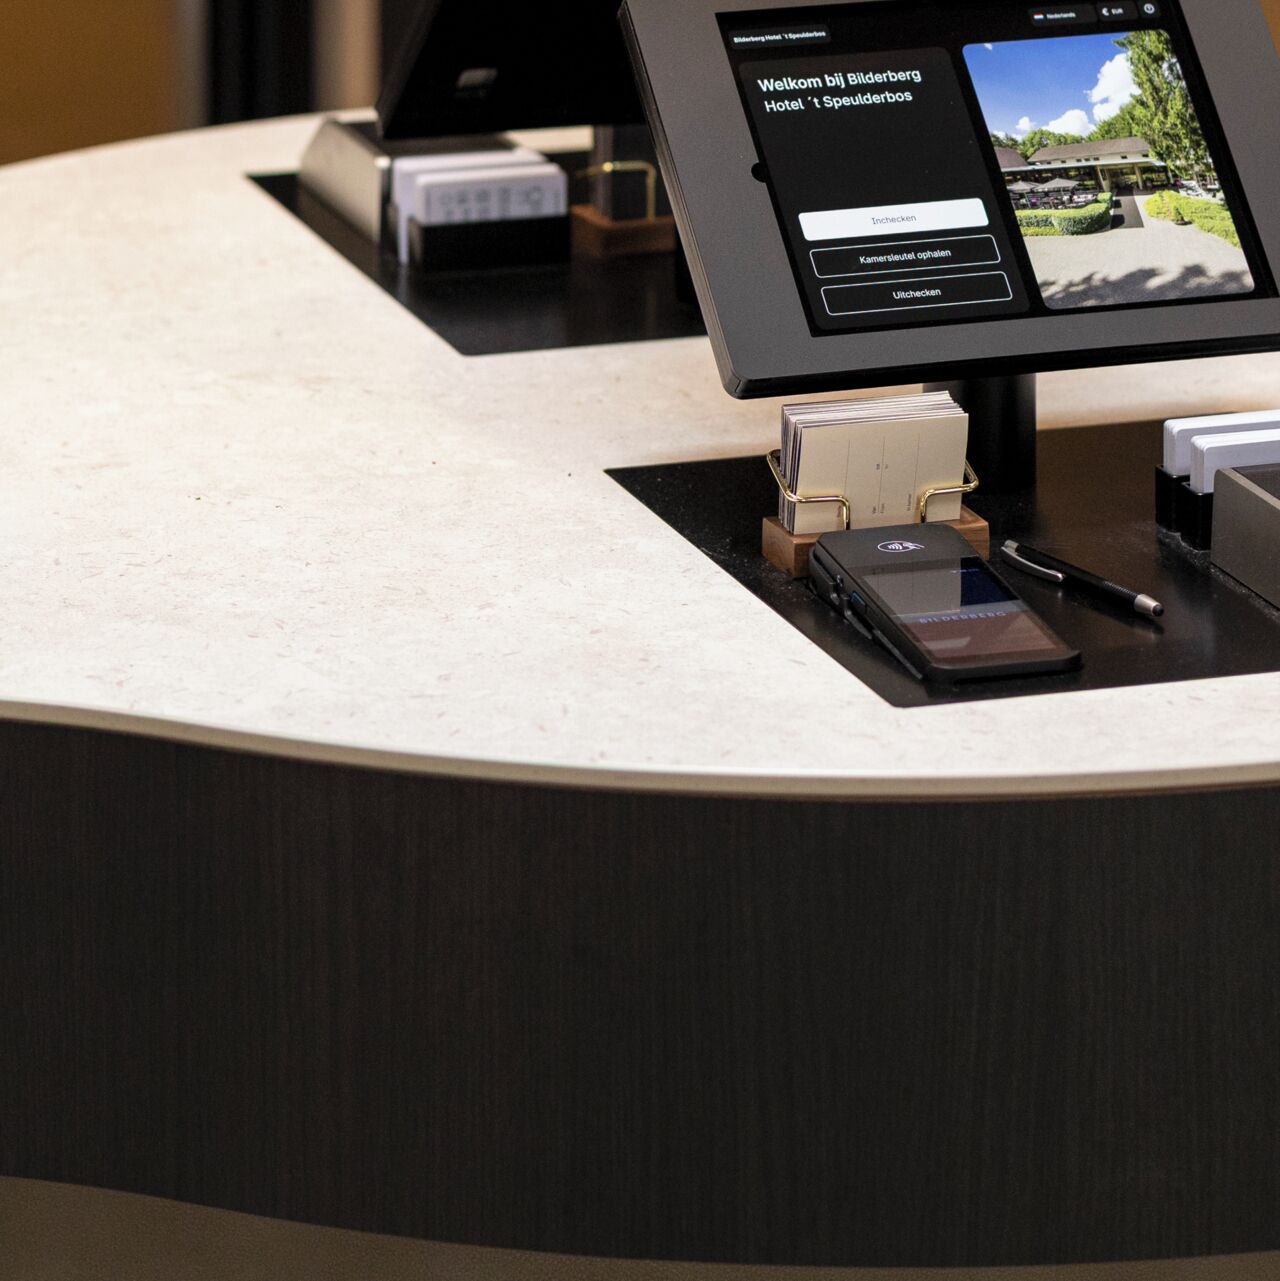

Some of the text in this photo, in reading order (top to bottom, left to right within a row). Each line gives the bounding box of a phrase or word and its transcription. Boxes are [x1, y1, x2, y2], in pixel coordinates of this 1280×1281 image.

[733, 35, 765, 43] Bilderberg
[788, 31, 826, 40] Speulderbos
[757, 69, 921, 92] Welkom bij Bilderberg
[764, 97, 804, 113] Hotel
[823, 91, 913, 109] Speulderbos
[871, 214, 917, 225] Inchecken
[859, 249, 951, 264] Kamersleutel ophalen
[892, 288, 941, 299] Uitchecken
[919, 611, 1008, 624] BILDERBERG
